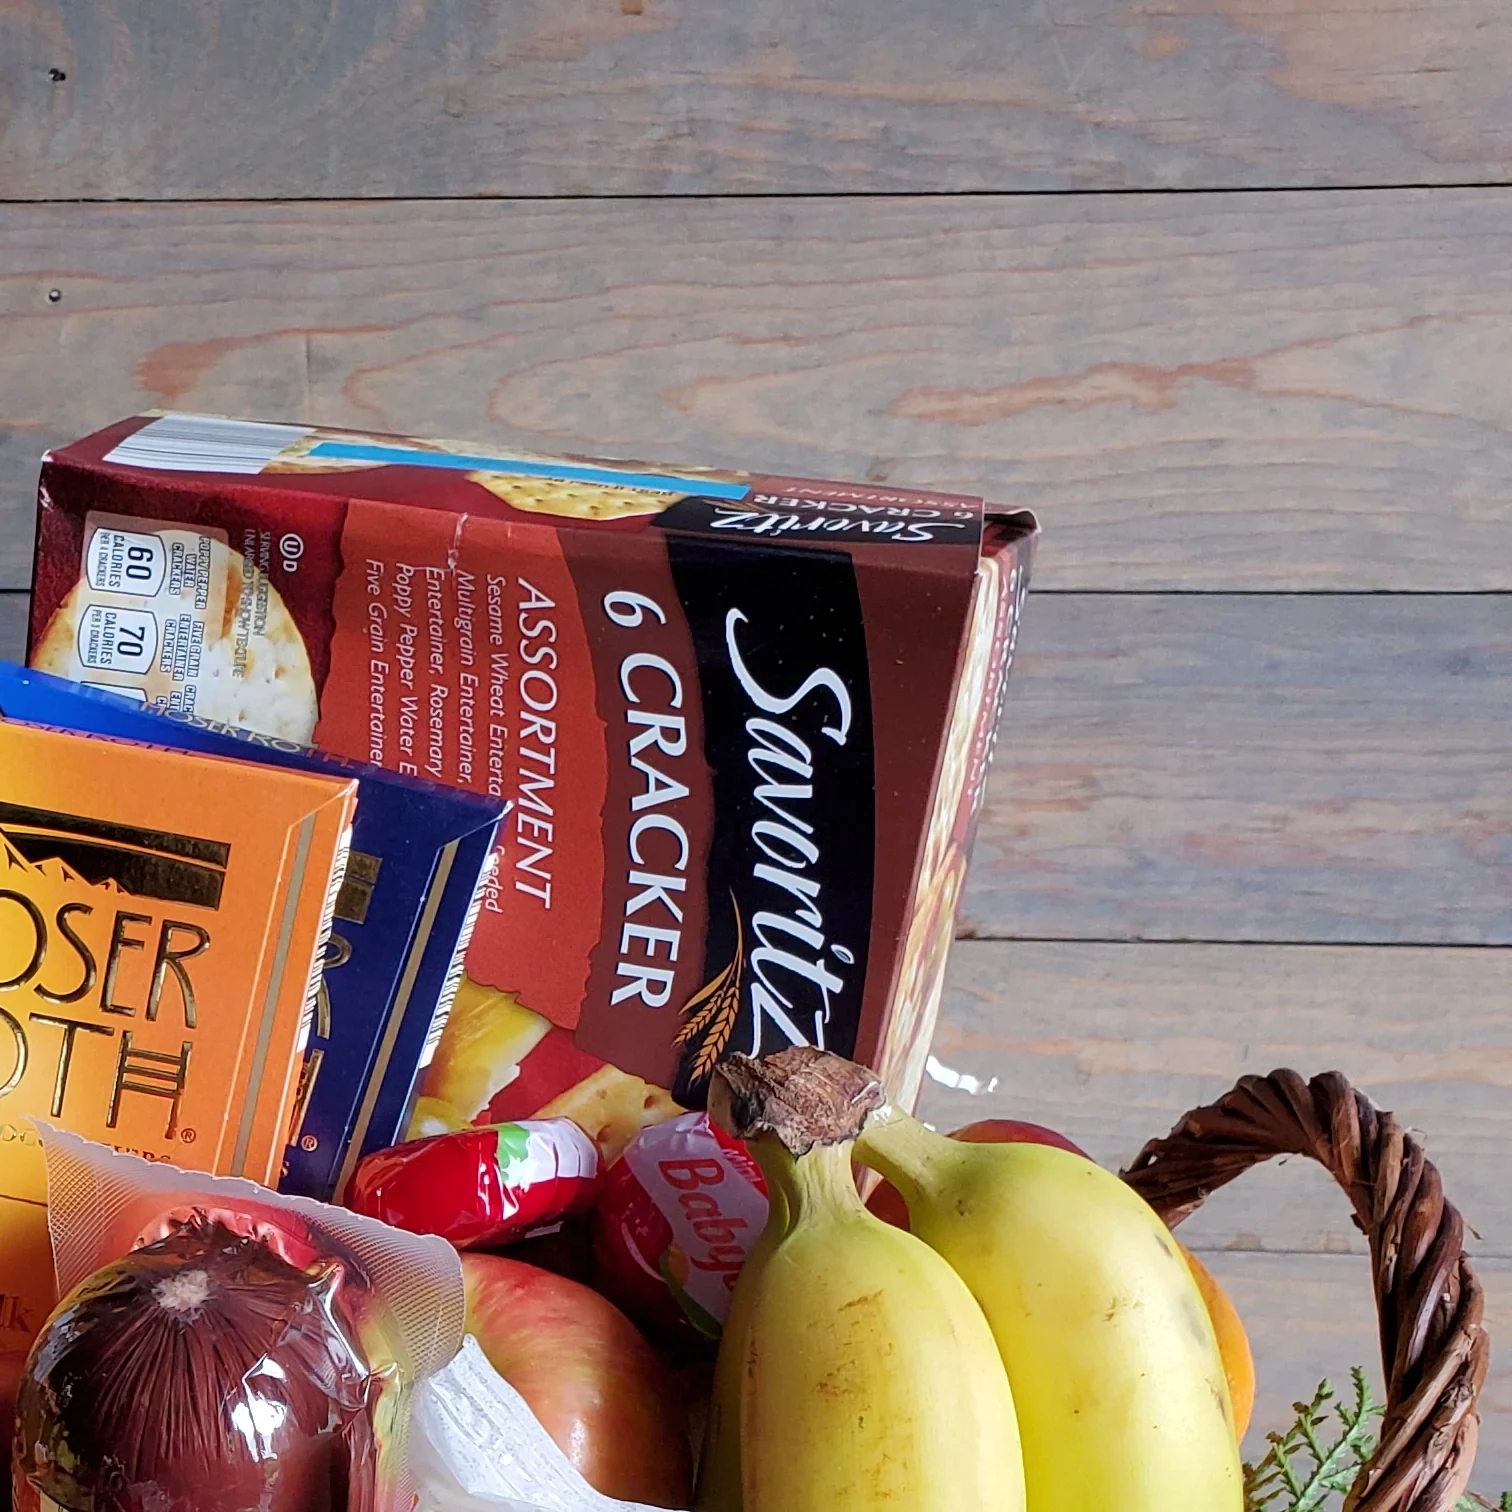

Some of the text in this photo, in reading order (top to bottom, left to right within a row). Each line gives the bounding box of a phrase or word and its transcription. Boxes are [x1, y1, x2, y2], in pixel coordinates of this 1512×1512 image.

[709, 506, 966, 544] Savoritz
[753, 492, 931, 520] CRACKER
[95, 551, 108, 586] CRACKERS
[108, 534, 124, 587] CALORIES
[125, 546, 153, 580] 60
[168, 542, 184, 595] CRACKERS
[183, 553, 196, 587] WATER
[194, 536, 210, 609] POPPY PEPPER
[364, 559, 385, 595] Five
[392, 561, 414, 617] Poppy
[86, 629, 100, 664] CRACKERS
[99, 611, 116, 664] CALORIES
[116, 625, 145, 657] 70
[159, 619, 176, 672] CRACKERS
[172, 613, 190, 681] ENTERTAINER
[187, 621, 204, 677] FIVE GRAIN
[366, 601, 388, 652] Grain
[396, 622, 417, 690] Pepper
[422, 566, 447, 778] Entertainer, Rosemary
[452, 569, 477, 784] Multigrain Entertainer,
[182, 684, 196, 713] CRAC
[485, 574, 508, 798] Sesame Wheat Enterta
[397, 695, 418, 758] Water
[514, 577, 557, 909] ASSORTMENT
[601, 589, 689, 1007] 6 CRACKER
[724, 607, 854, 1060] Savoritz
